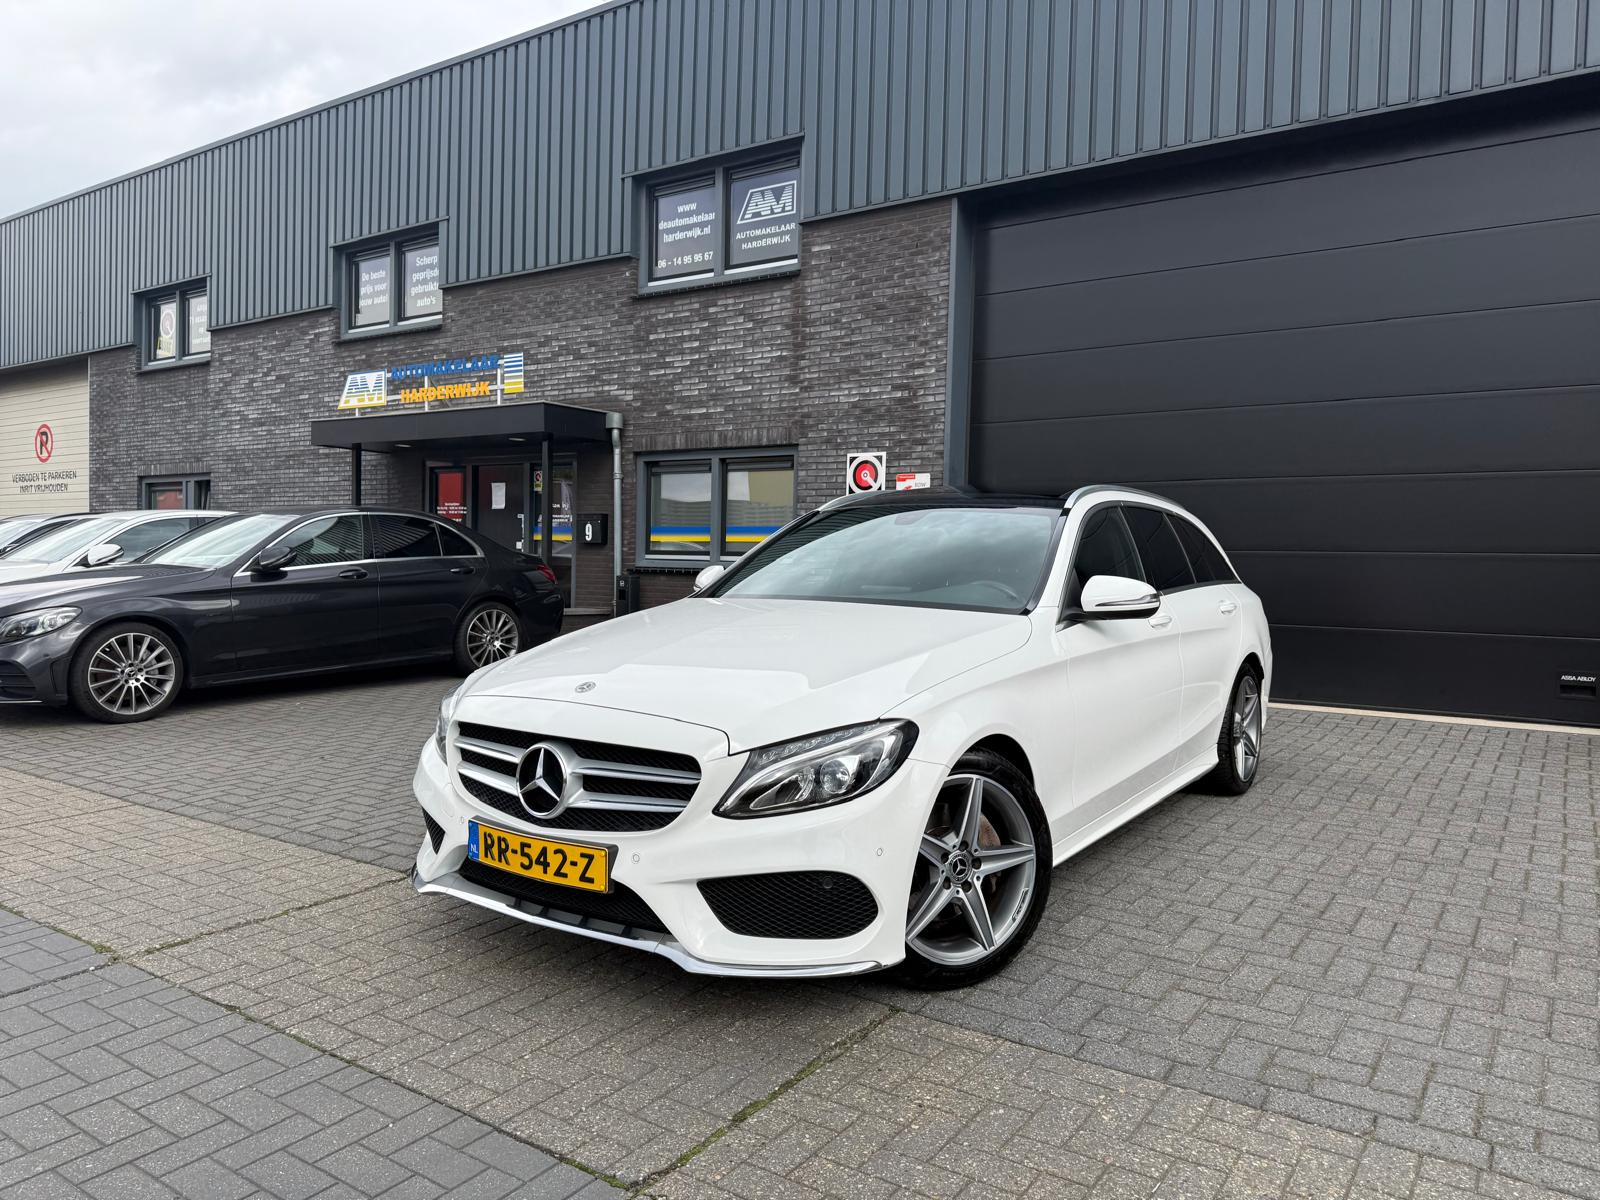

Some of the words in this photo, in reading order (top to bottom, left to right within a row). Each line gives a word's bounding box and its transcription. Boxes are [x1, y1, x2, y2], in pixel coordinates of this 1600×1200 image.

[677, 203, 697, 213] www
[658, 212, 716, 230] deautomakelaar
[663, 225, 711, 243] harderwijk.nl
[736, 223, 796, 240] AUTOMAKELAAR
[742, 234, 791, 250] HARDERWIJK
[416, 256, 438, 267] Scherp
[657, 259, 667, 269] 06
[673, 256, 682, 266] 14
[683, 254, 693, 265] 95
[693, 253, 703, 263] 95
[704, 251, 714, 261] 67
[370, 269, 386, 280] beste
[360, 285, 374, 296] prijs
[416, 295, 437, 307] auto's
[390, 355, 500, 380] AUTOMAKELAAR
[400, 381, 491, 404] HARDERWIJK
[12, 472, 40, 484] VERBODEN
[40, 472, 48, 482] TE
[48, 470, 77, 481] PARKEREN
[19, 484, 33, 493] INRIT
[585, 523, 593, 541] 9
[470, 844, 478, 853] NL
[483, 831, 595, 884] RR-542-Z
